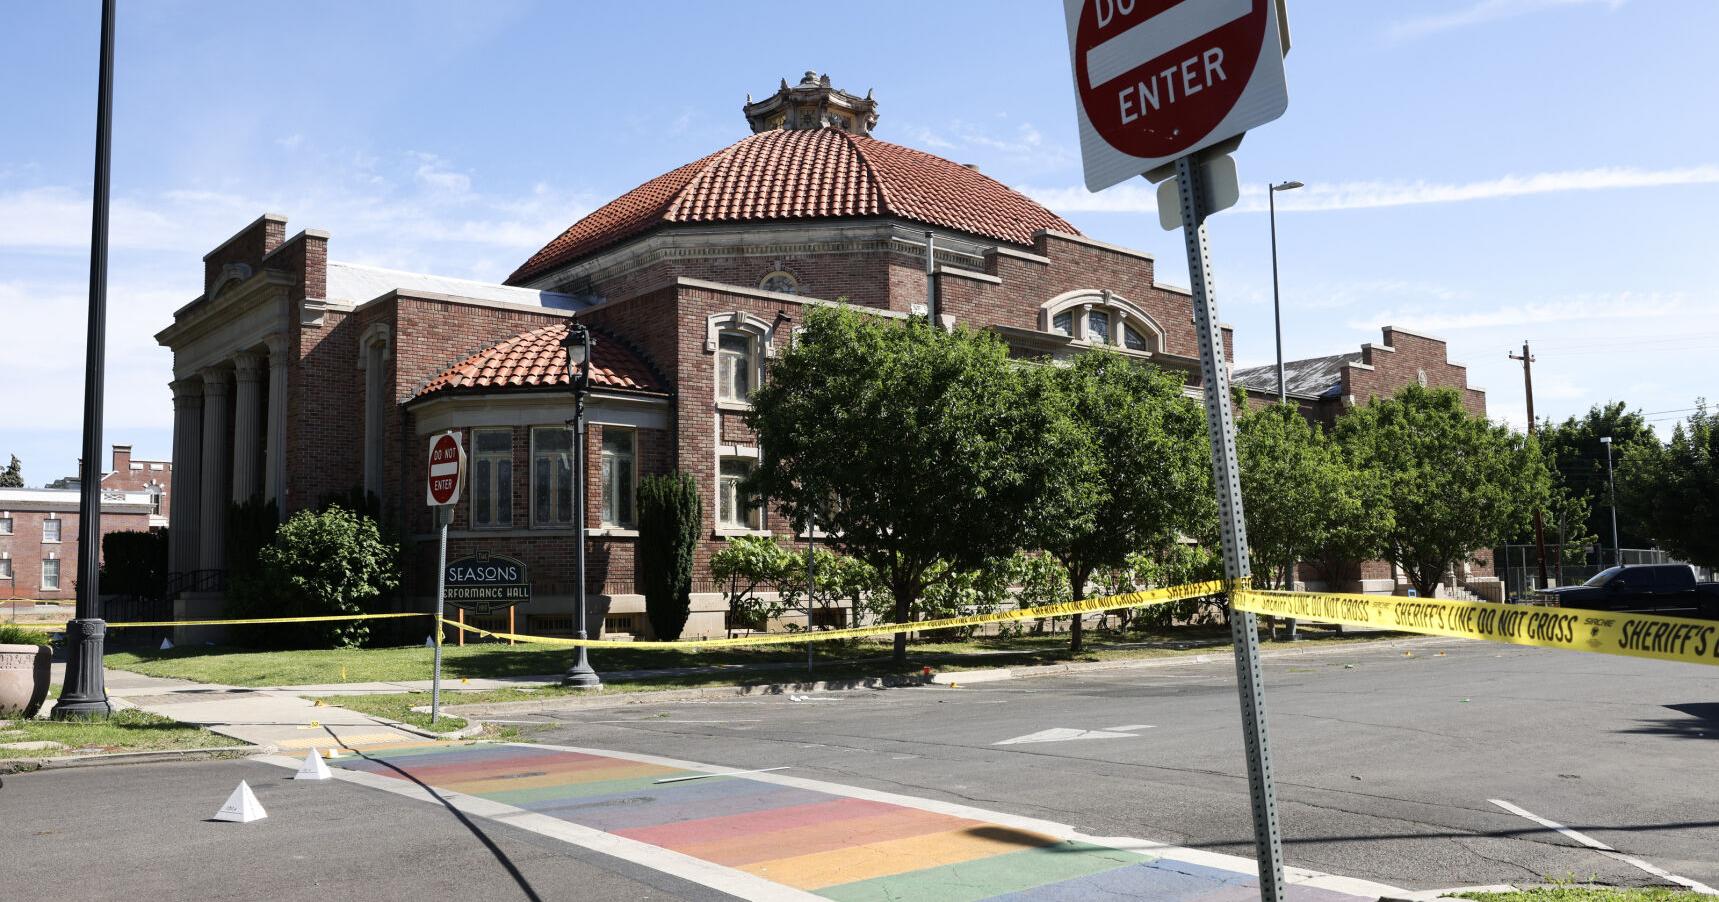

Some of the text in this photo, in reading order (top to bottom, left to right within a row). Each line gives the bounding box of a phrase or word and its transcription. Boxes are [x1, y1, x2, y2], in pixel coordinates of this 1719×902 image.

[1118, 47, 1228, 125] ENTER
[433, 447, 457, 461] DO NOT
[434, 478, 453, 491] ENTER
[448, 566, 517, 582] SEASONS
[443, 587, 529, 599] ERFORMANCE HALL
[1312, 595, 1322, 617] DO
[1324, 596, 1340, 619] NOT
[1341, 598, 1369, 622] CROSS
[1394, 602, 1578, 643] SHERIFF'S LINE DO NOT CROSS
[1618, 619, 1715, 656] SHERIFF'S
